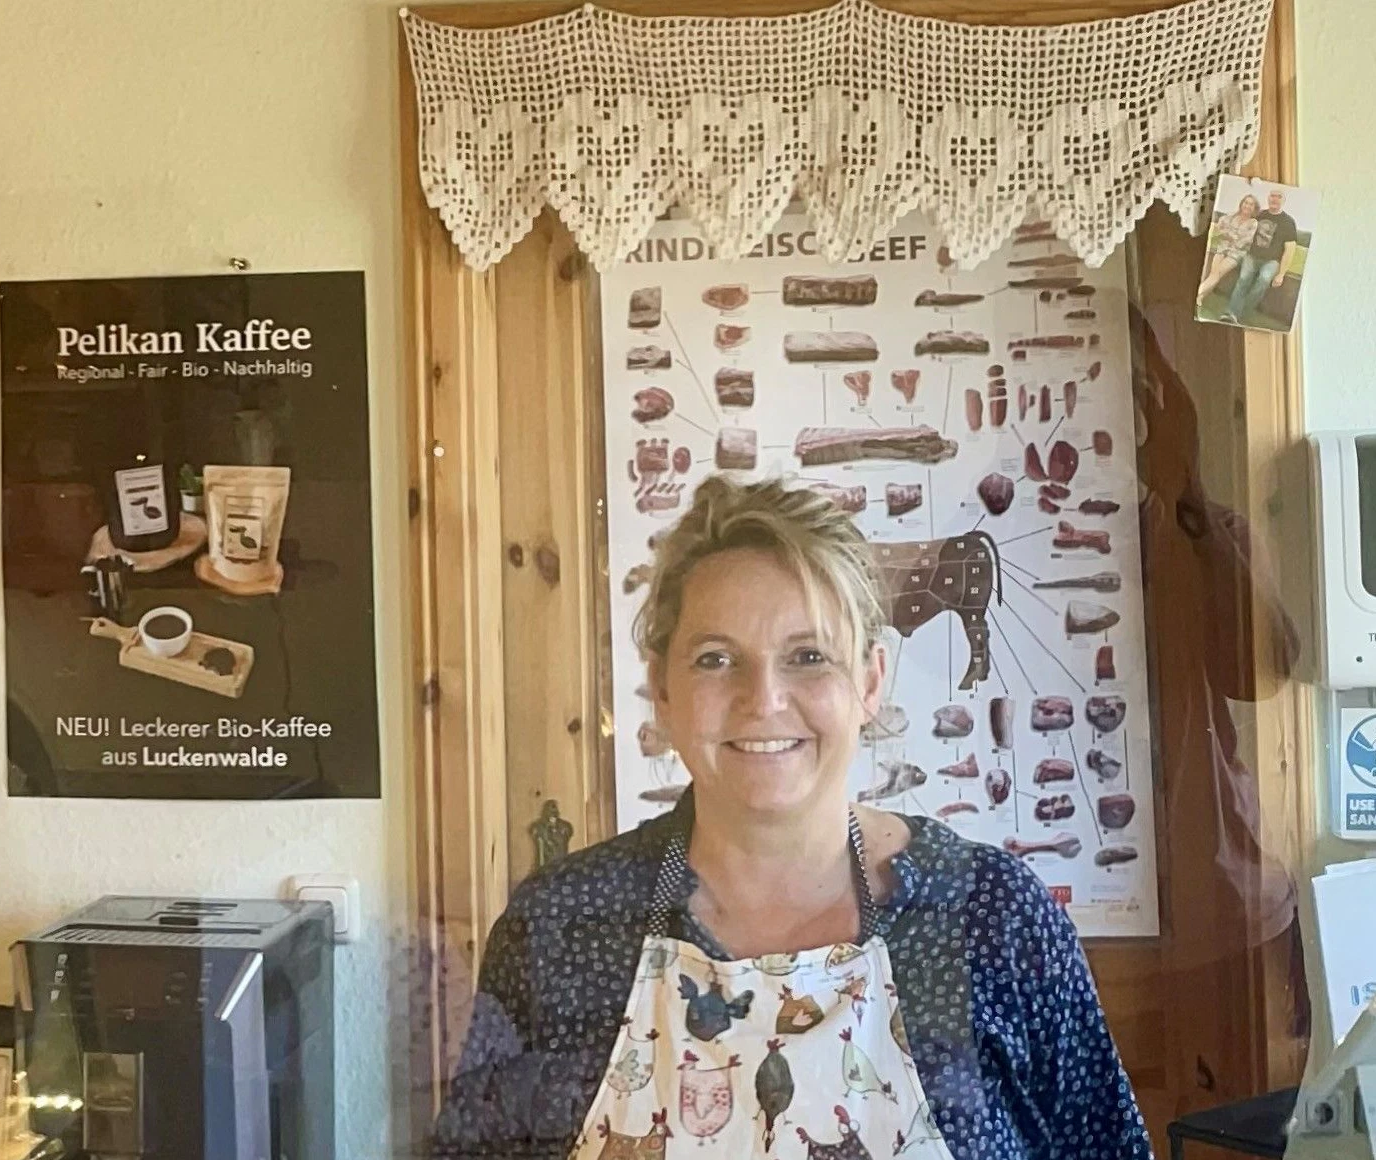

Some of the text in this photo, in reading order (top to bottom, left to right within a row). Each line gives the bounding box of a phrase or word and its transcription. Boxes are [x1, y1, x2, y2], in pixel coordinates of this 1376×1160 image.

[848, 236, 926, 262] EEF
[57, 319, 312, 356] Pelikan Kaffee
[56, 363, 125, 383] Regional
[138, 363, 168, 377] Fair
[182, 361, 209, 377] Bio
[223, 359, 312, 378] Nachhaltig
[56, 716, 332, 738] NEU! Leckerer Bio-Kaffee
[102, 746, 288, 767] aus Luckenwalde
[1350, 799, 1375, 810] USE
